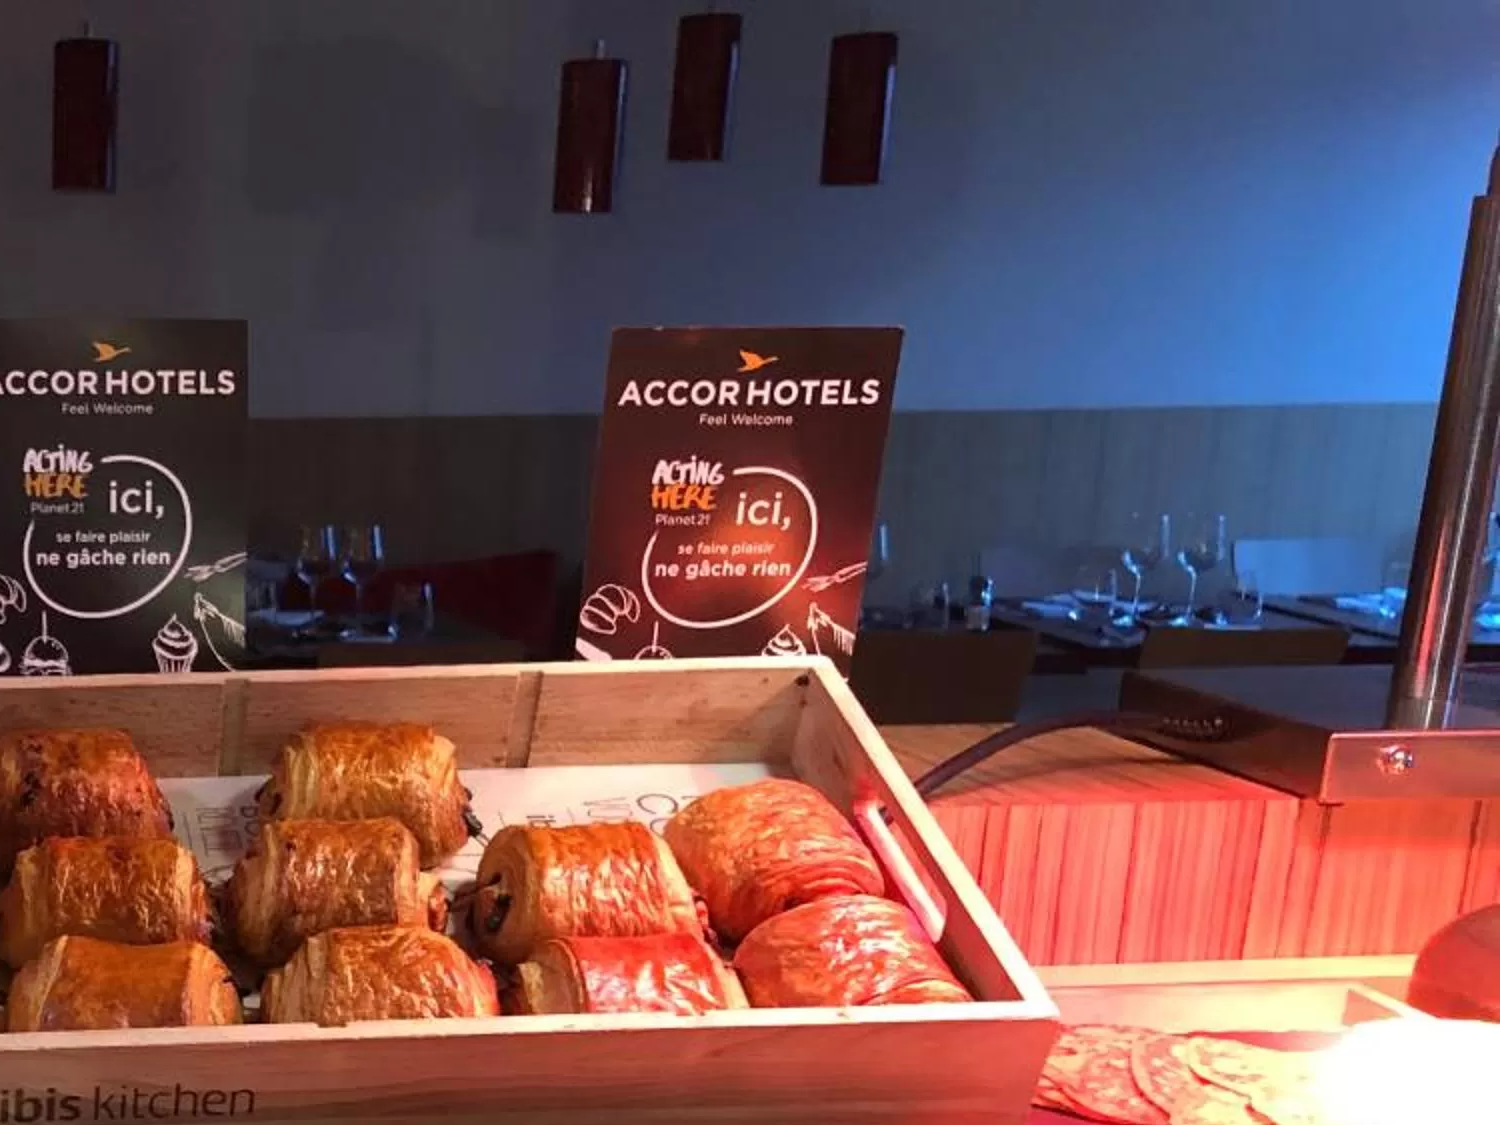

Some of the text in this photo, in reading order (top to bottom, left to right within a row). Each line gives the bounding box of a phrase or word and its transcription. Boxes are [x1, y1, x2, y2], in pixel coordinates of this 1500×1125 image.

[104, 370, 236, 395] HOTELS
[617, 379, 881, 406] ACCOR HOTELS
[61, 403, 154, 415] Feel Welcome
[699, 413, 793, 426] Feel Welcome
[24, 473, 89, 499] HERE
[651, 485, 717, 511] HERE
[108, 480, 165, 519] ici,
[736, 492, 792, 531] ici,
[55, 530, 152, 546] se faire plaisir
[677, 542, 775, 558] se faire plaisir
[36, 548, 172, 570] ne gâche rien
[654, 558, 792, 581] ne gâche rien
[92, 1082, 256, 1121] kitchen
